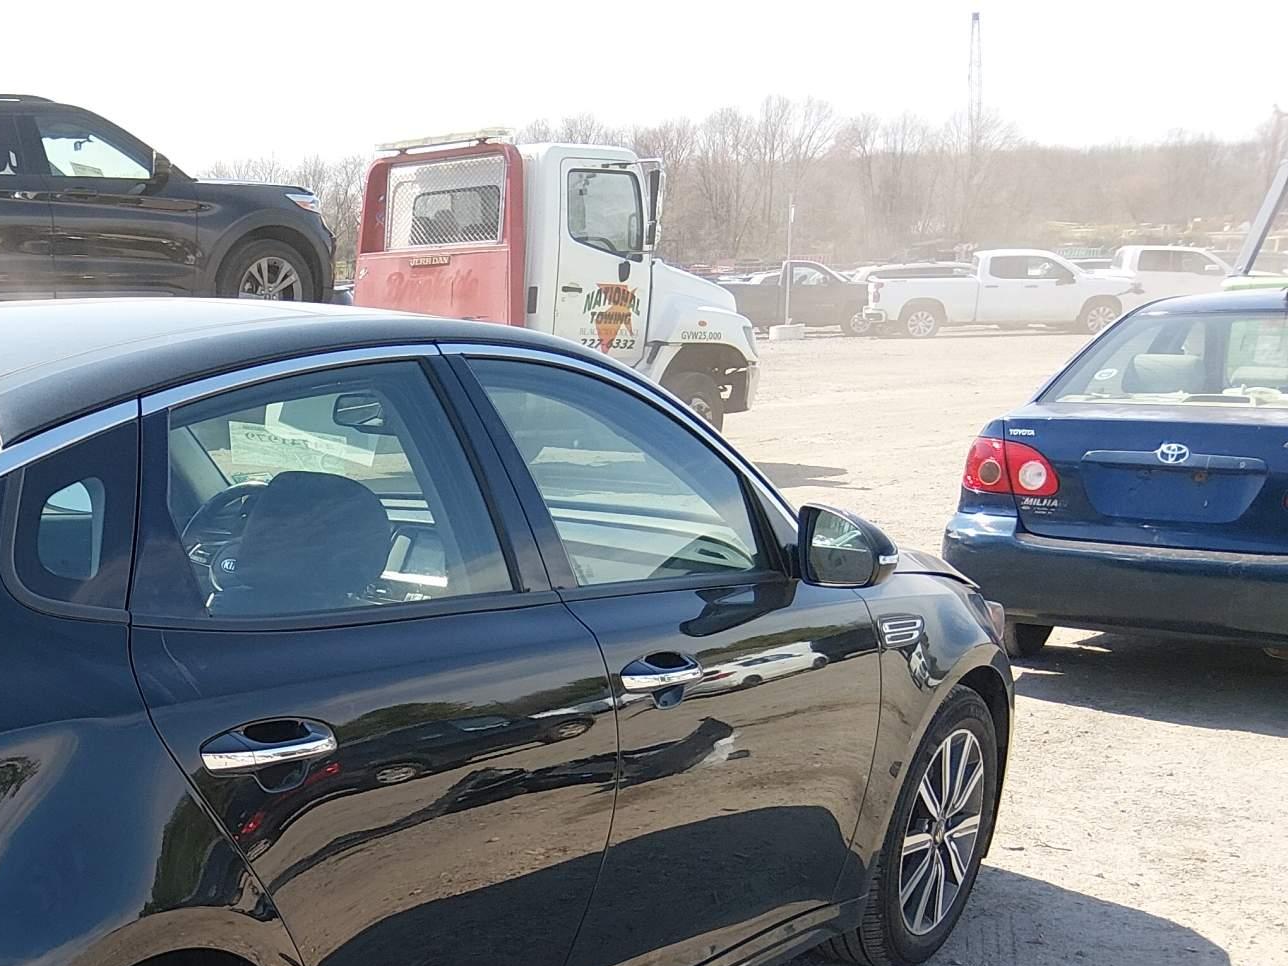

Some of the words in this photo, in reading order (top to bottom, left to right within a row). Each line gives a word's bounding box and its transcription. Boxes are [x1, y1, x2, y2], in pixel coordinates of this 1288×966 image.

[583, 286, 640, 316] NATIONAL
[590, 311, 632, 325] TOWING
[1009, 428, 1036, 436] TOYOTA
